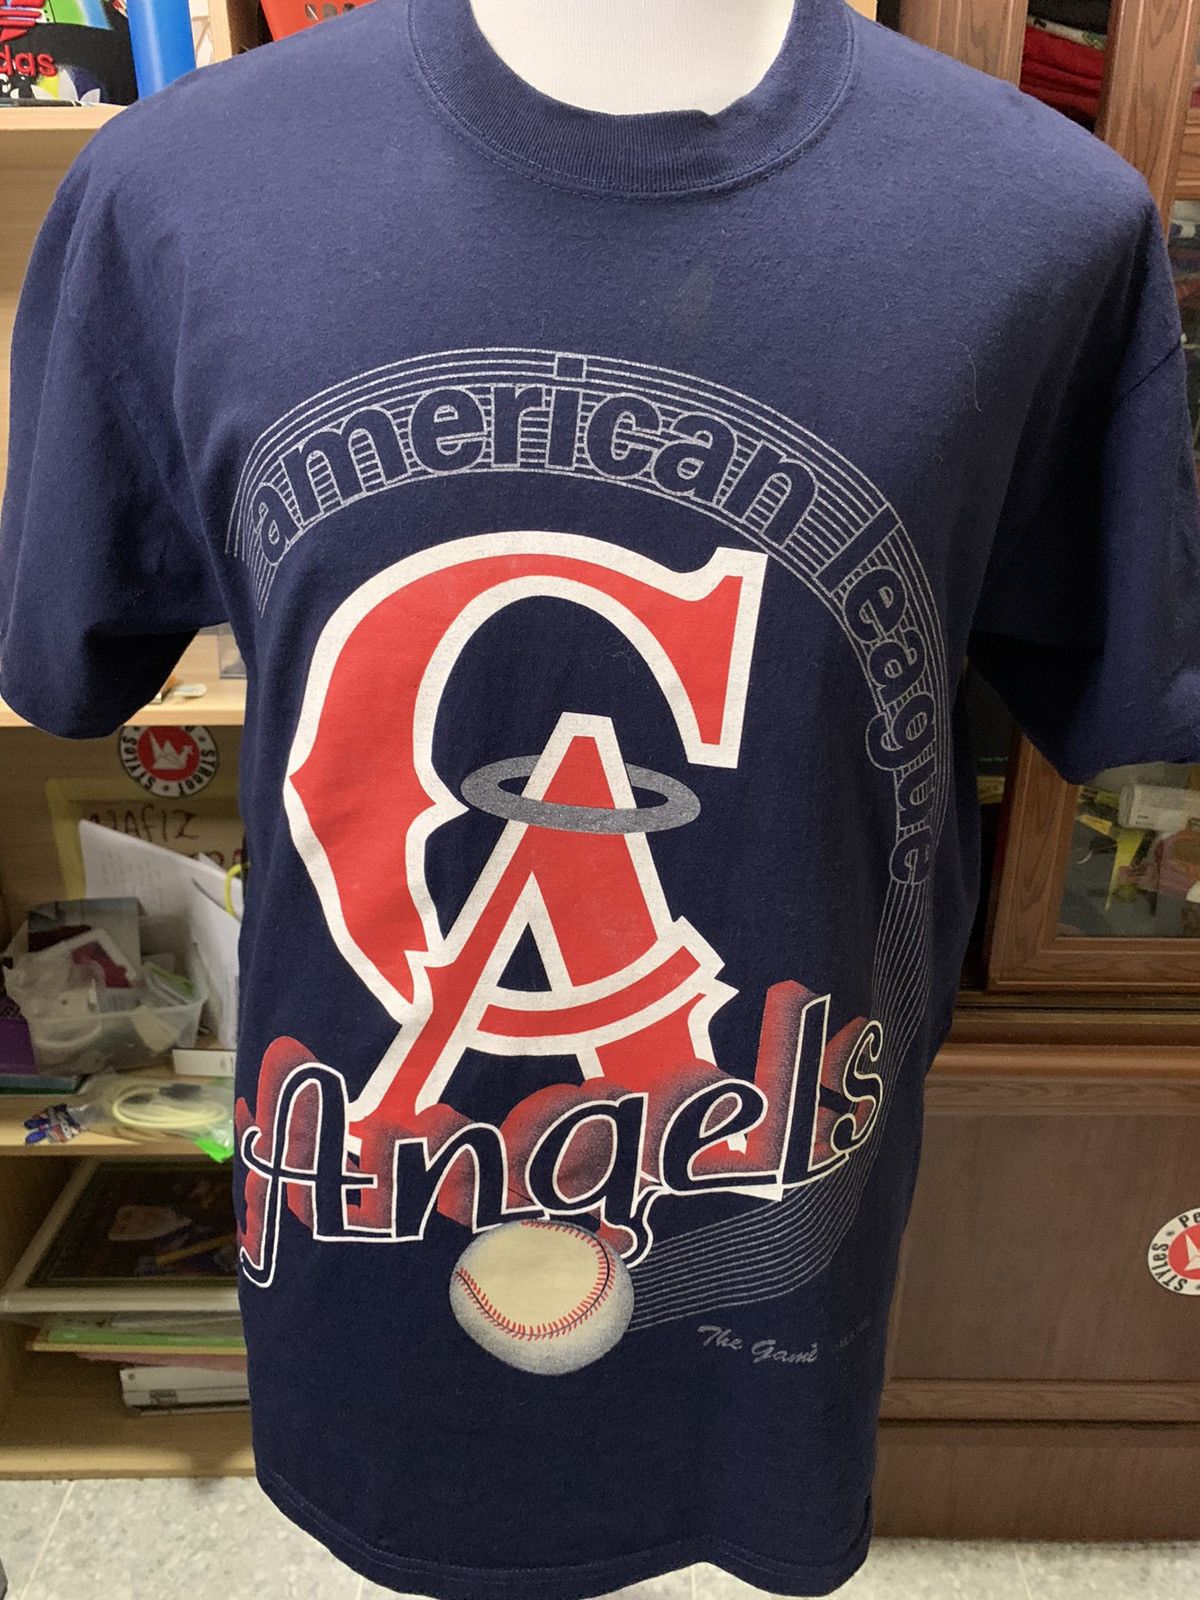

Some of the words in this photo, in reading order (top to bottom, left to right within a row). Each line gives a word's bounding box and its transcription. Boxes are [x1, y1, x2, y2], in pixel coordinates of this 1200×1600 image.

[250, 353, 819, 565] american
[815, 503, 937, 885] league
[238, 990, 884, 1287] Angels
[697, 1325, 744, 1351] The
